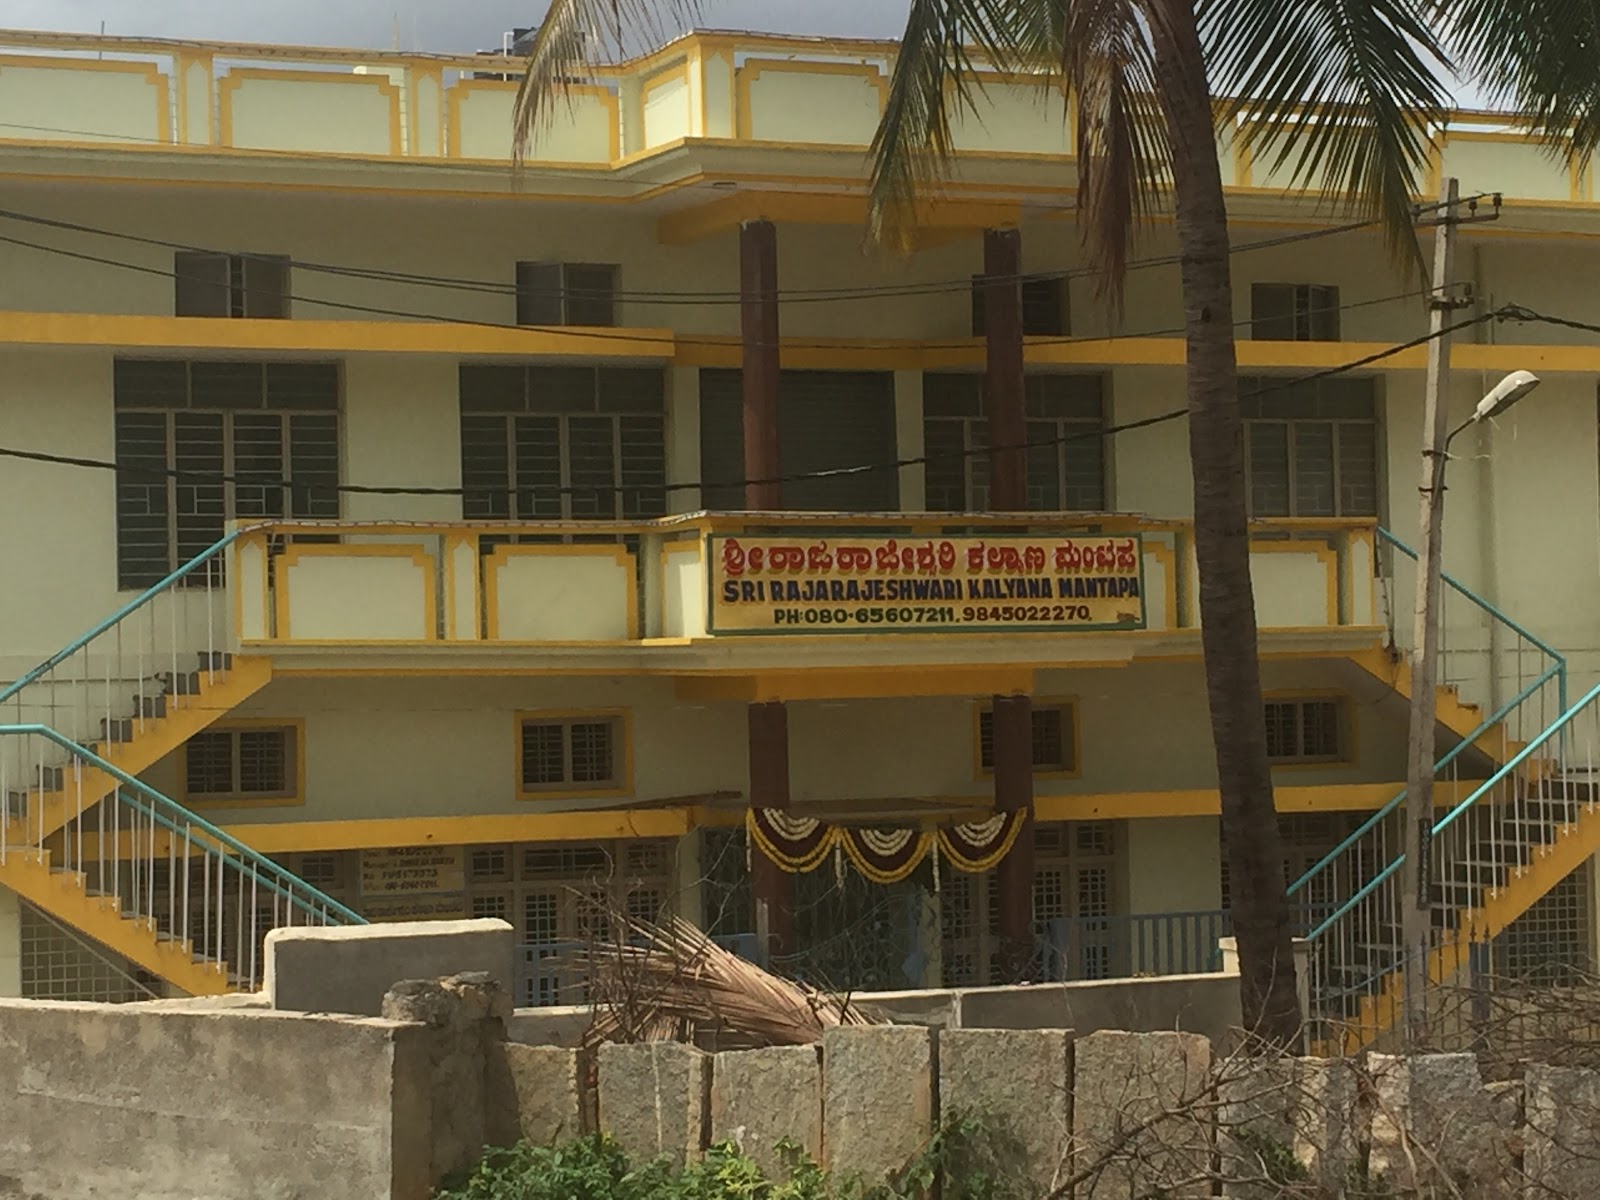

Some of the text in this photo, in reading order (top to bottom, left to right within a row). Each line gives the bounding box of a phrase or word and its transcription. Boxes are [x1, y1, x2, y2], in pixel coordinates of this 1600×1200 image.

[967, 541, 1046, 576] ಕಲ್ಯಾಣ
[1055, 539, 1136, 572] ಮಂಟಪ
[723, 576, 1140, 602] SRI RAJARAJESHWARI KALYANA MANTAPA
